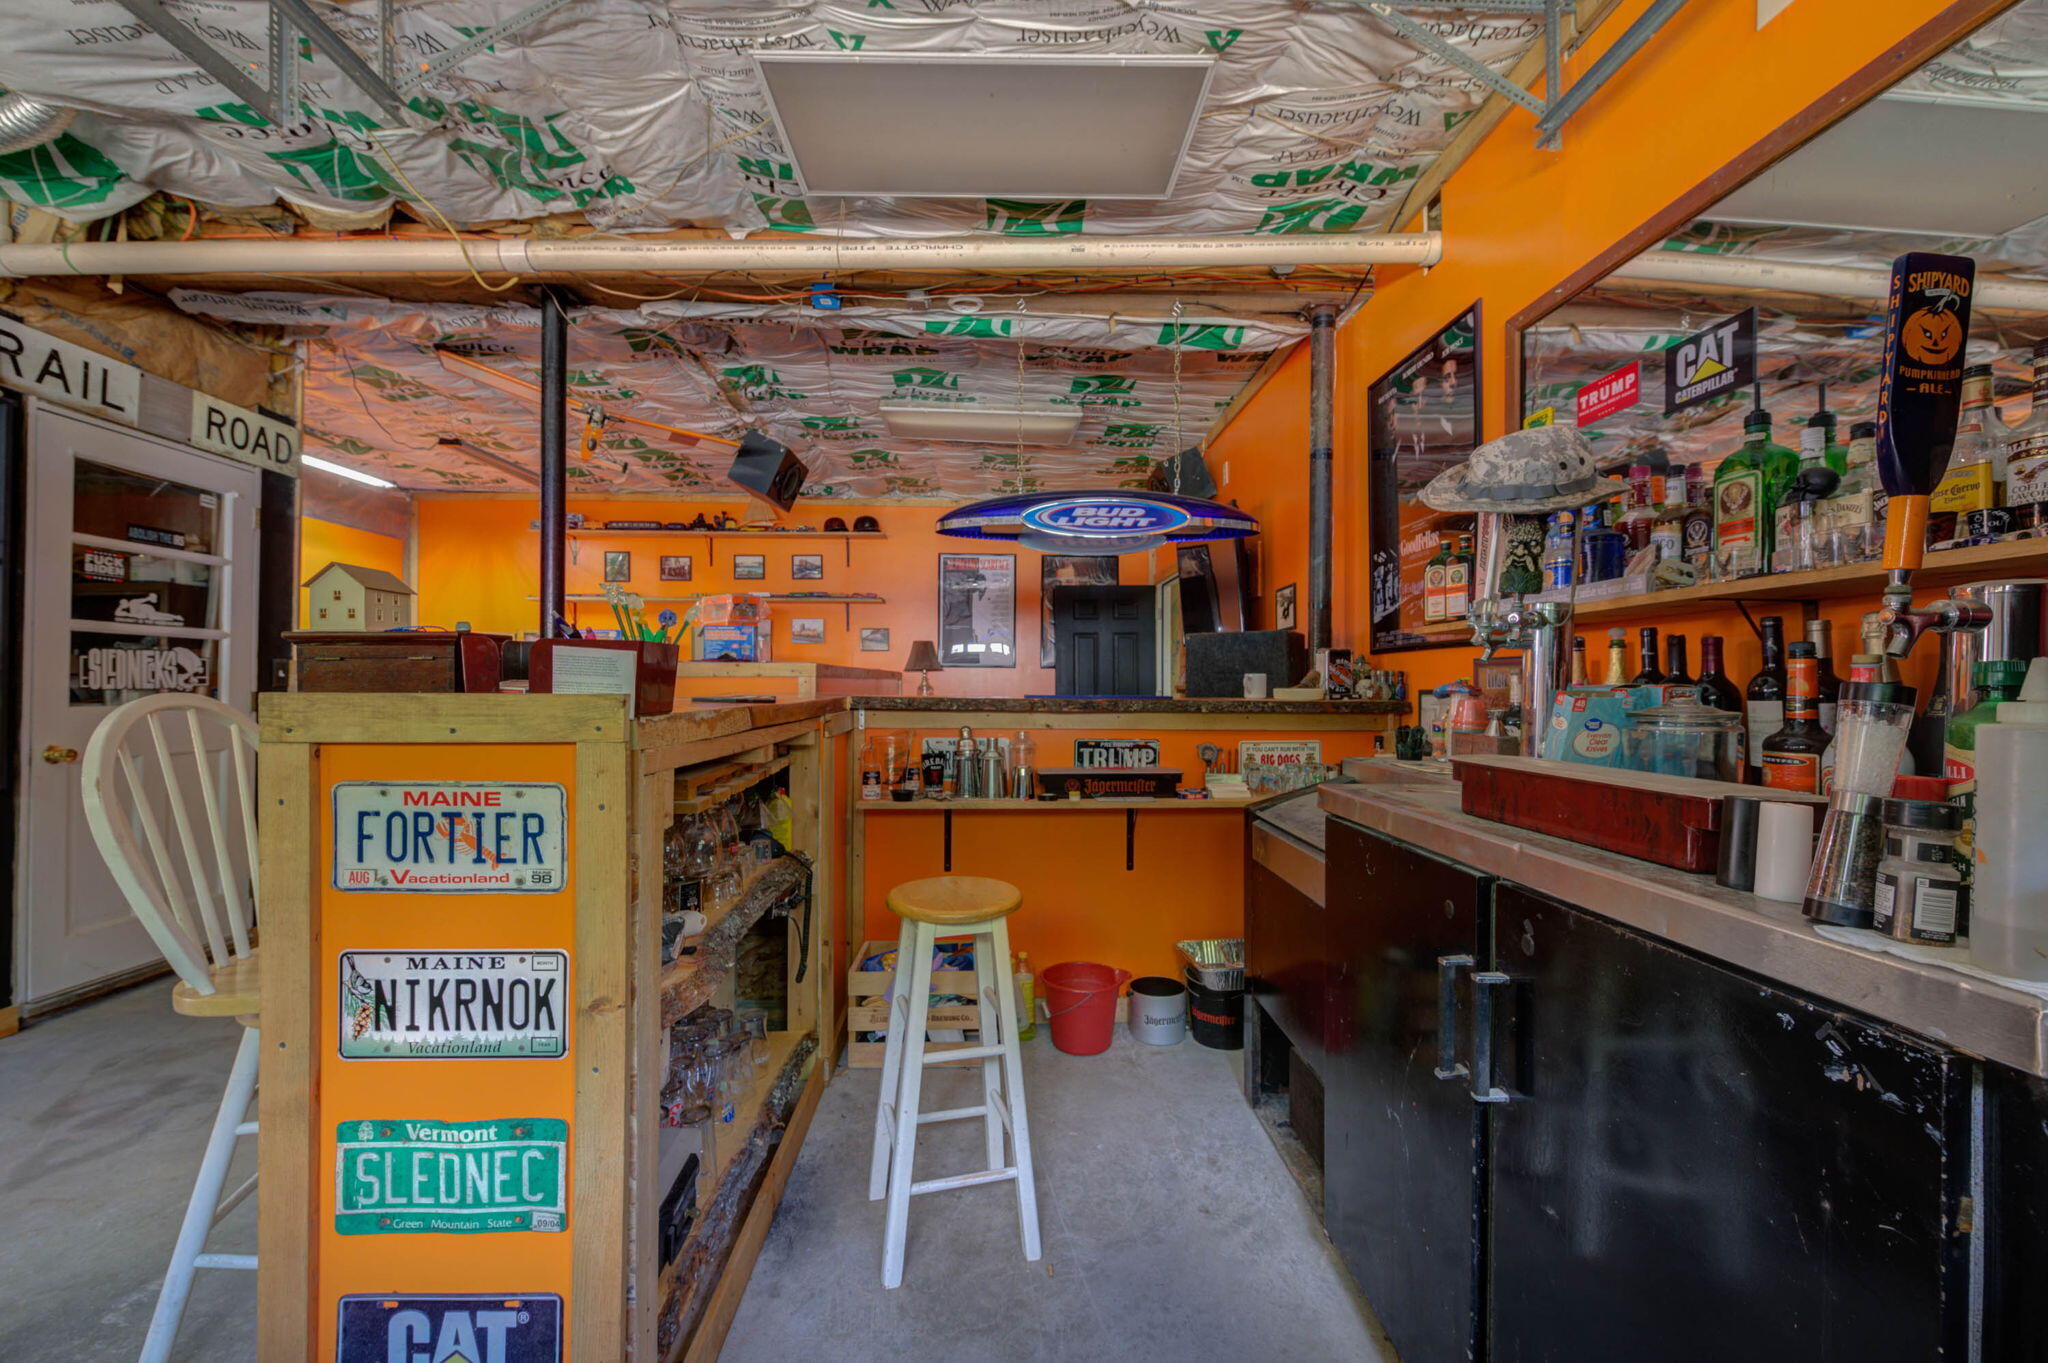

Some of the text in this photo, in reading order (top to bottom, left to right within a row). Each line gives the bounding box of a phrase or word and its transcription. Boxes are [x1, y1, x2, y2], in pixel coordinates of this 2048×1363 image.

[1016, 14, 1182, 45] Weyerhaeuser
[1272, 99, 1421, 127] Weyerhaeuser
[1250, 161, 1420, 188] WRAP
[1908, 271, 1970, 298] SHIPYARD
[1676, 321, 1740, 388] CAT
[1878, 274, 1901, 425] SHIPYARD
[0, 328, 125, 412] RAIL
[1580, 373, 1635, 409] TRUMP
[1674, 373, 1735, 404] CATERPILLAR
[1919, 382, 1944, 394] ALE
[206, 406, 292, 464] ROAD
[1072, 507, 1147, 518] BUD
[1057, 517, 1156, 528] LIGHT
[84, 552, 125, 567] FUCK
[84, 564, 125, 578] BIDEN
[1080, 748, 1156, 768] TRUMP
[1277, 753, 1301, 766] DOGS
[1084, 778, 1156, 794] Jägermeister
[403, 791, 501, 806] MAINE
[357, 810, 544, 864] FORTIER
[348, 871, 370, 884] AUG
[390, 869, 510, 885] Vacationland
[531, 874, 552, 884] 98
[406, 956, 506, 970] MAINE
[374, 978, 556, 1031] NIKRNOK
[408, 1040, 503, 1055] Vacationland
[405, 1123, 498, 1142] Vermont
[356, 1149, 545, 1205] SLEDNEC
[393, 1218, 512, 1230] Green Mountain State
[388, 1309, 517, 1363] CAT
